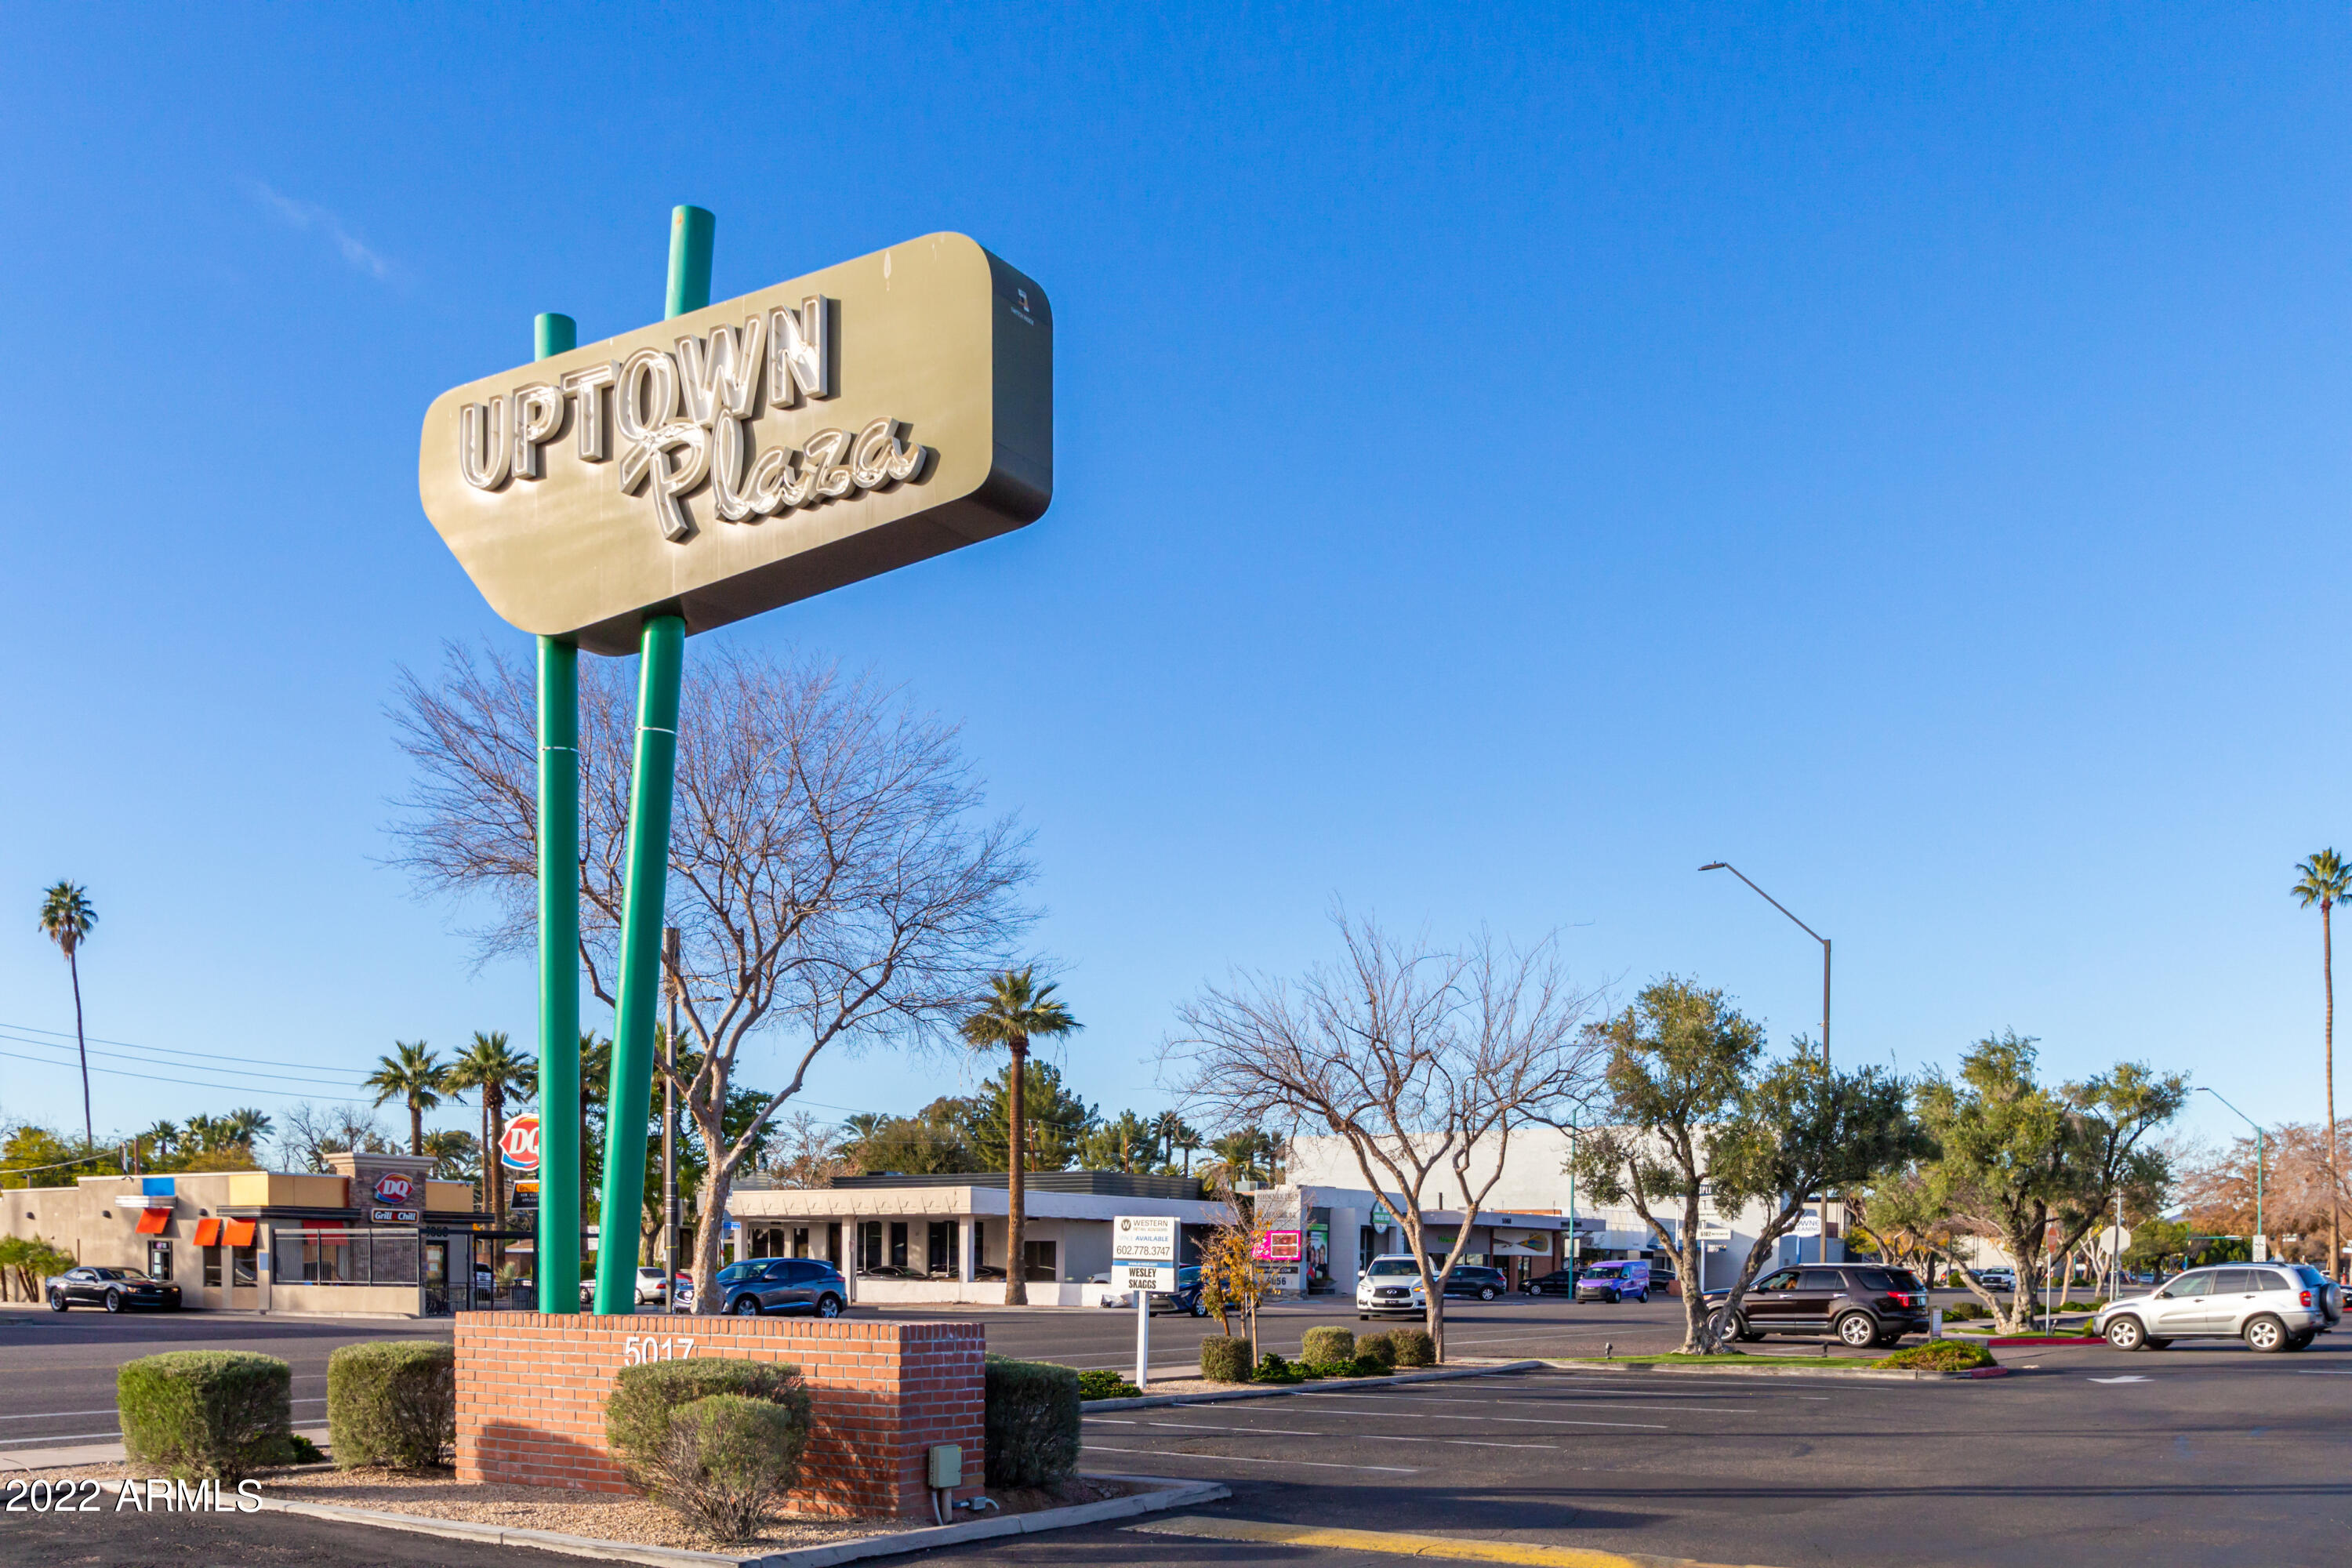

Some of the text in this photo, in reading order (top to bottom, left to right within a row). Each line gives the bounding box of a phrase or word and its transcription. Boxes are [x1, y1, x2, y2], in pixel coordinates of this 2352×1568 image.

[459, 293, 828, 492] UPTOWN
[619, 405, 927, 543] Plaza
[383, 1180, 408, 1198] DQ
[375, 1211, 392, 1220] Grill
[397, 1212, 416, 1221] Chill
[1116, 1245, 1171, 1256] 602.778.3747
[1129, 1267, 1157, 1278] WESLEY
[1129, 1279, 1156, 1289] SKAGGS
[624, 1336, 695, 1367] 5017
